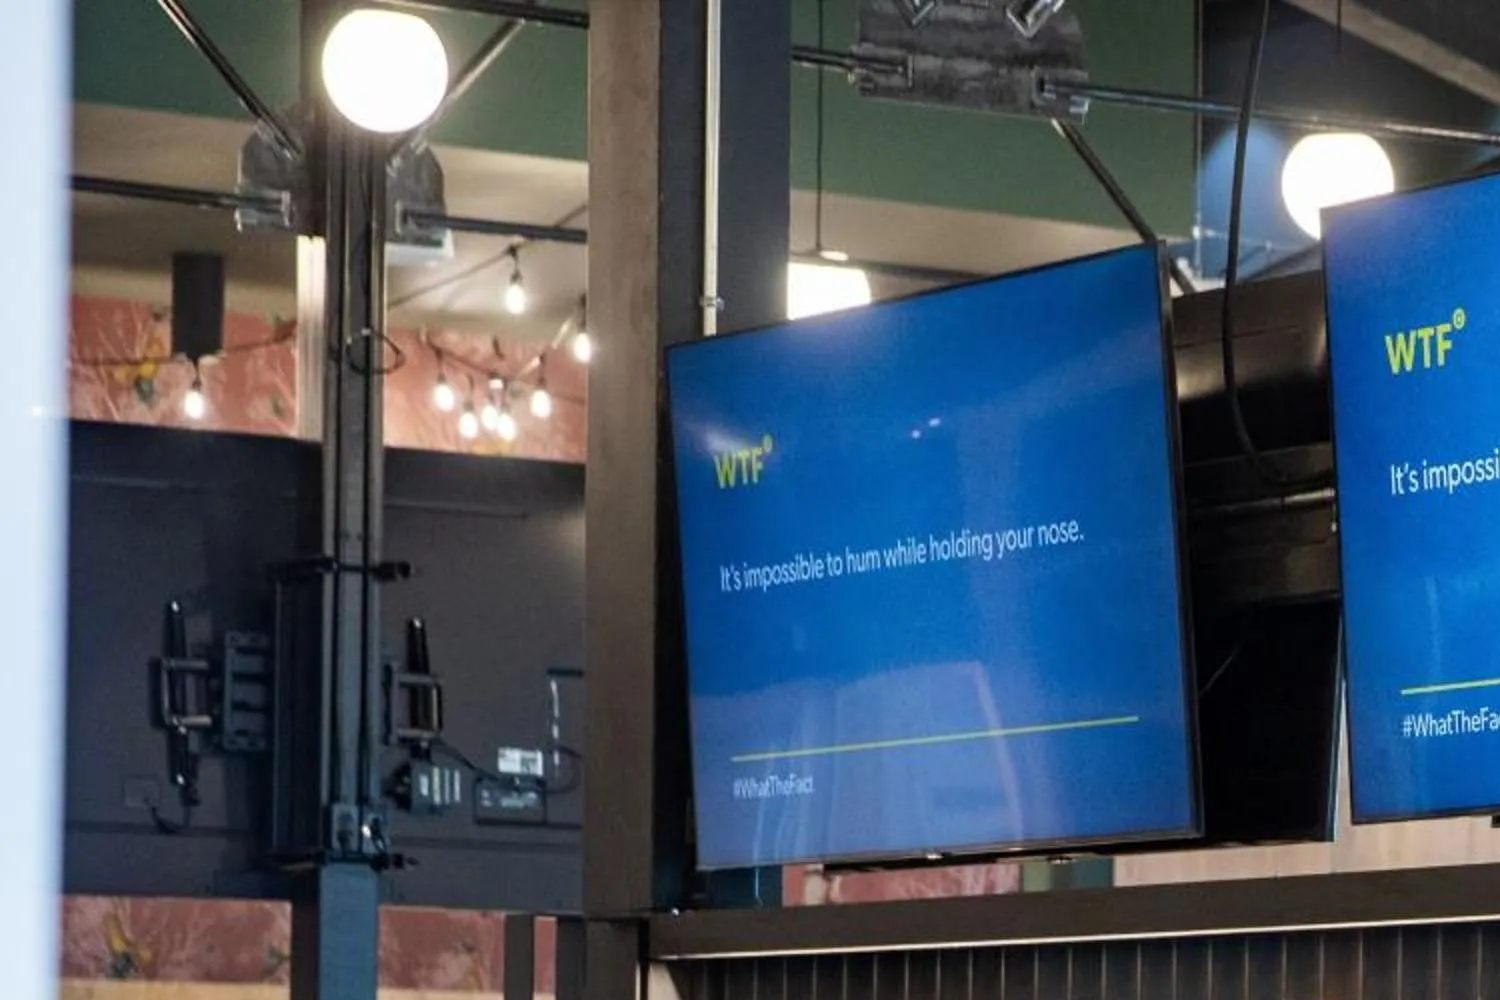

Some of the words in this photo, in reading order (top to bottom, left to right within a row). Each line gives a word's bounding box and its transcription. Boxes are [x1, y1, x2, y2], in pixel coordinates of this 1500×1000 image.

[1384, 322, 1453, 375] WTF
[1390, 461, 1419, 496] It's
[719, 563, 742, 592] It's
[743, 551, 825, 592] impossible
[826, 550, 844, 577] to
[845, 545, 881, 574] hum
[883, 536, 927, 568] while
[929, 528, 994, 561] holding
[995, 524, 1035, 559] your
[1038, 518, 1085, 546] nose.
